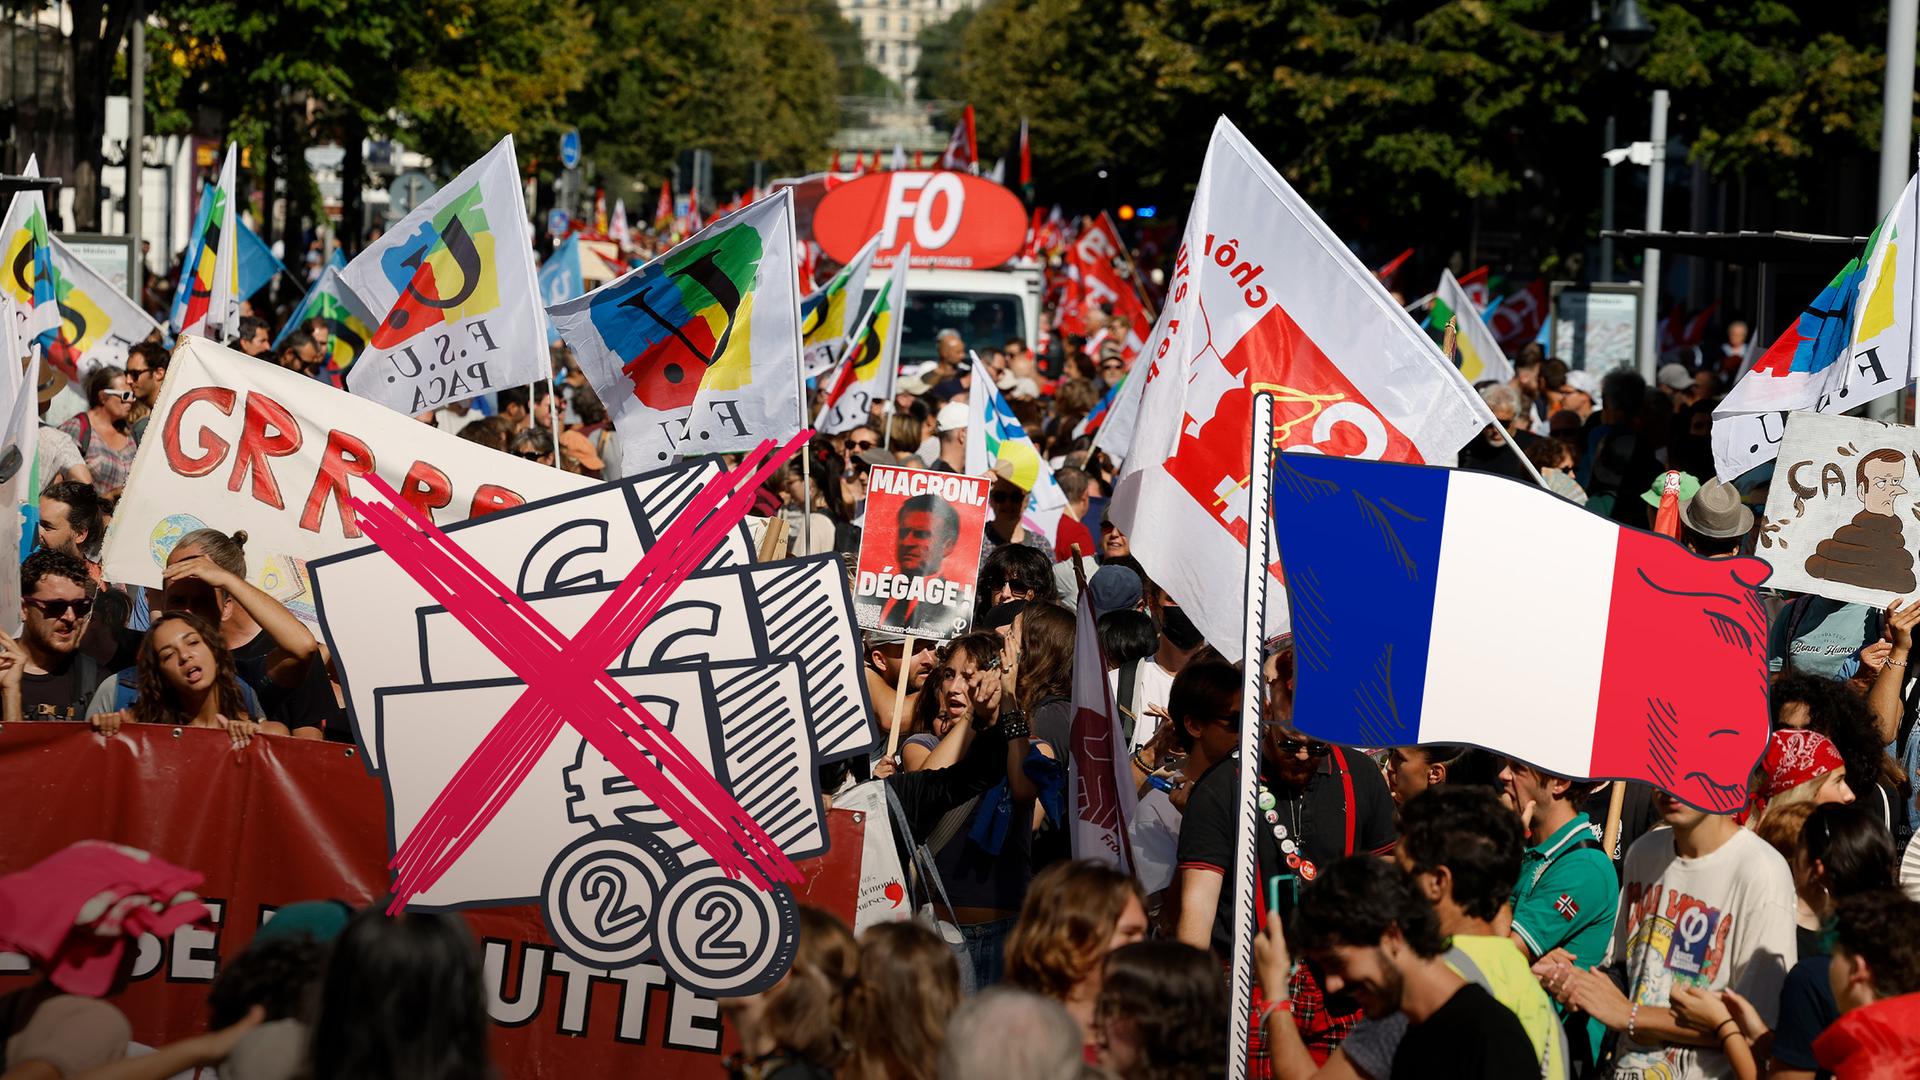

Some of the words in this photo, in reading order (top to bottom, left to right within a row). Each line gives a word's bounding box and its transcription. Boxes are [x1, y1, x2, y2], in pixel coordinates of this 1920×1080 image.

[880, 171, 965, 250] FO
[871, 468, 987, 507] MACRON,
[1787, 459, 1848, 519] ÇA
[857, 565, 960, 606] DÉGAGE
[1790, 640, 1823, 655] Bonne
[1824, 642, 1860, 656] Humeu
[482, 940, 721, 1051] UTTE
